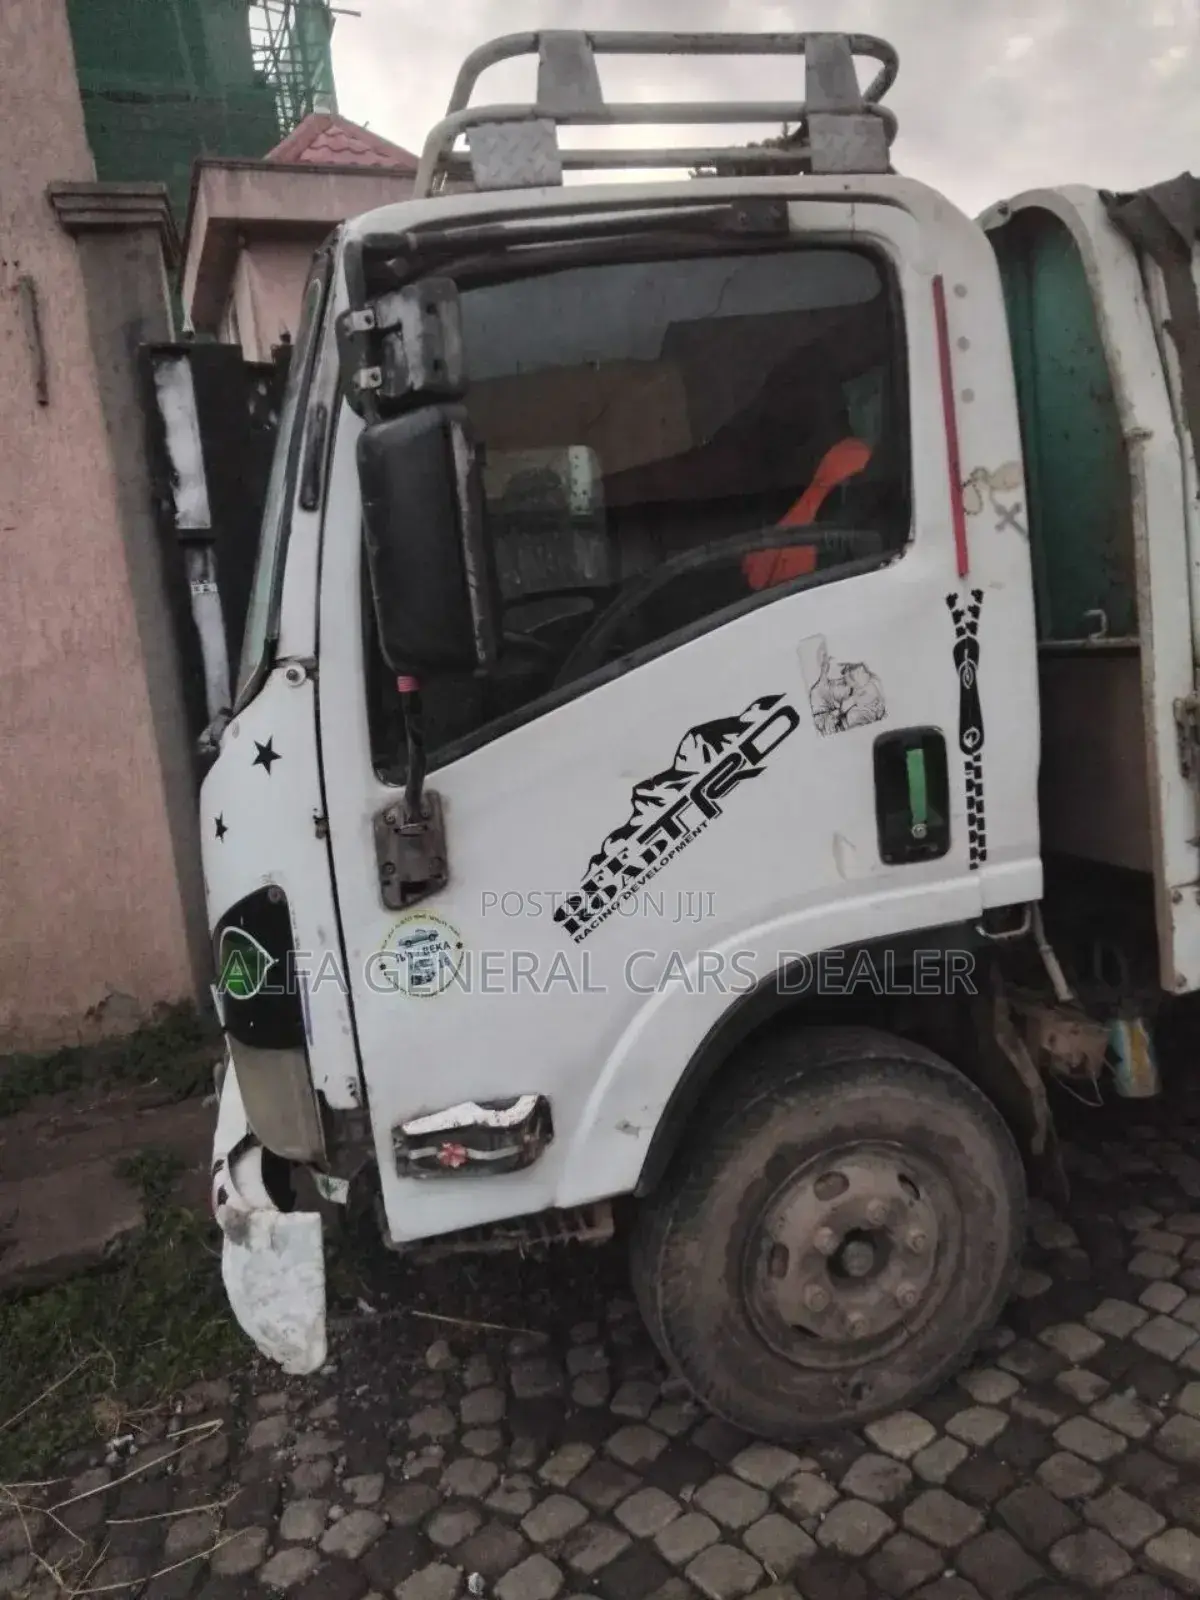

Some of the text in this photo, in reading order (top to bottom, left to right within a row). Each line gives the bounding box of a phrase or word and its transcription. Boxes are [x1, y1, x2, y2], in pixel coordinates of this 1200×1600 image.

[636, 705, 801, 846] TRD
[553, 847, 629, 923] OFF
[562, 838, 669, 936] ROAD
[573, 820, 709, 944] RACING DEVELOPMENT
